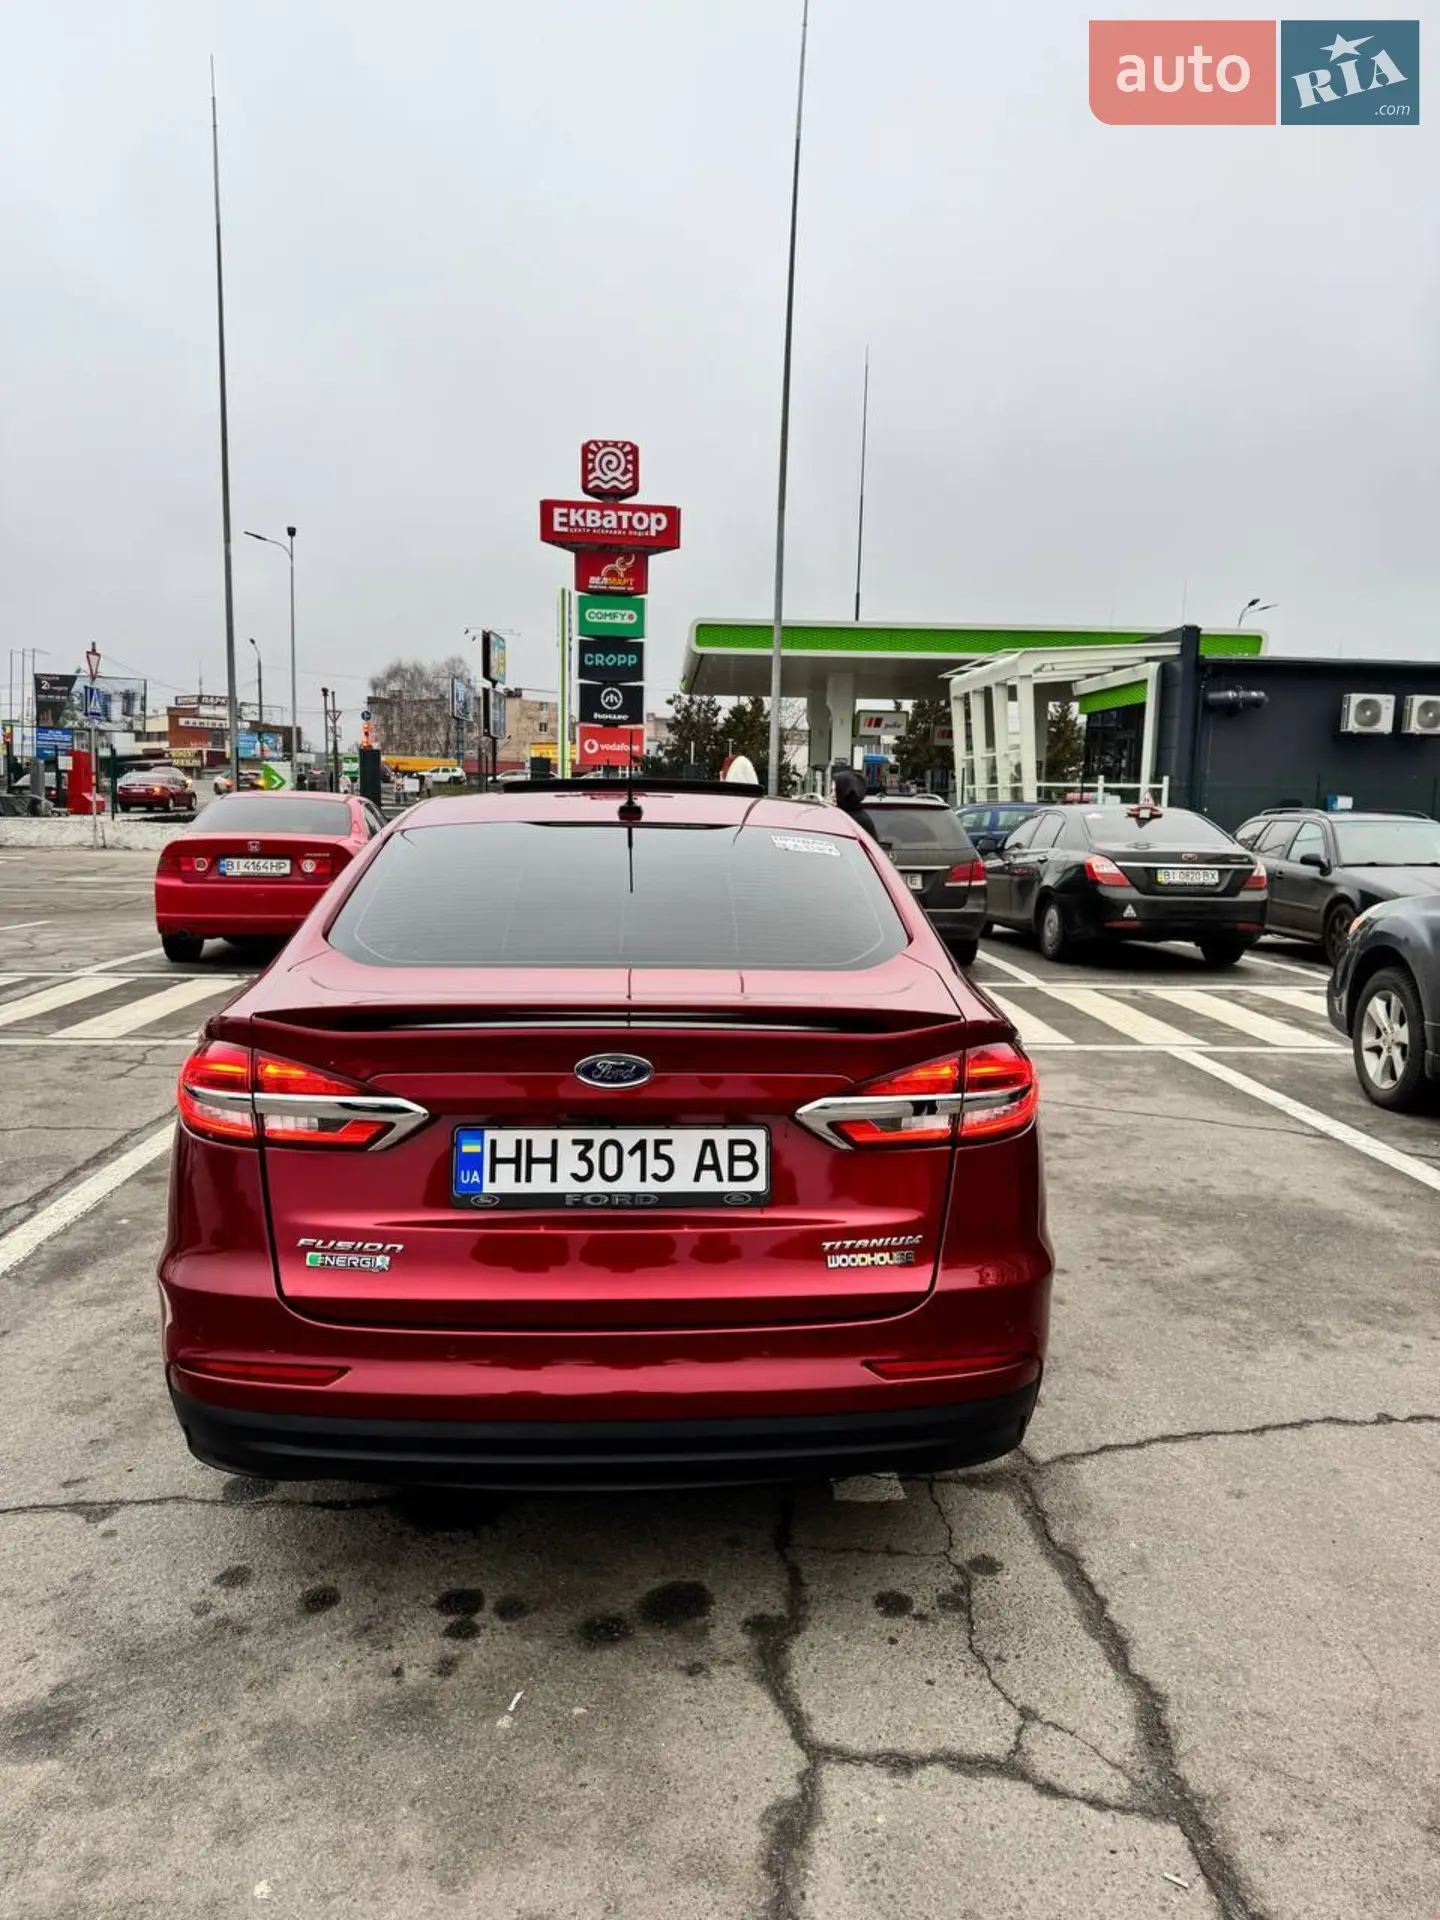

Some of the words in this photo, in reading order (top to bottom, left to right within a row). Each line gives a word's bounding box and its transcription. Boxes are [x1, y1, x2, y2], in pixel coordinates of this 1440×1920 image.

[588, 611, 626, 621] COMFY
[584, 653, 638, 667] CROPP
[244, 861, 268, 871] 4164
[592, 1060, 636, 1080] Ford
[461, 1170, 480, 1184] UA
[489, 1138, 558, 1183] HH
[570, 1138, 675, 1183] 3015
[693, 1138, 759, 1183] AB
[565, 1194, 659, 1206] FORD
[297, 1238, 404, 1253] FUSION
[822, 1235, 923, 1251] TITANIUM
[827, 1250, 915, 1268] WOODHOUSE
